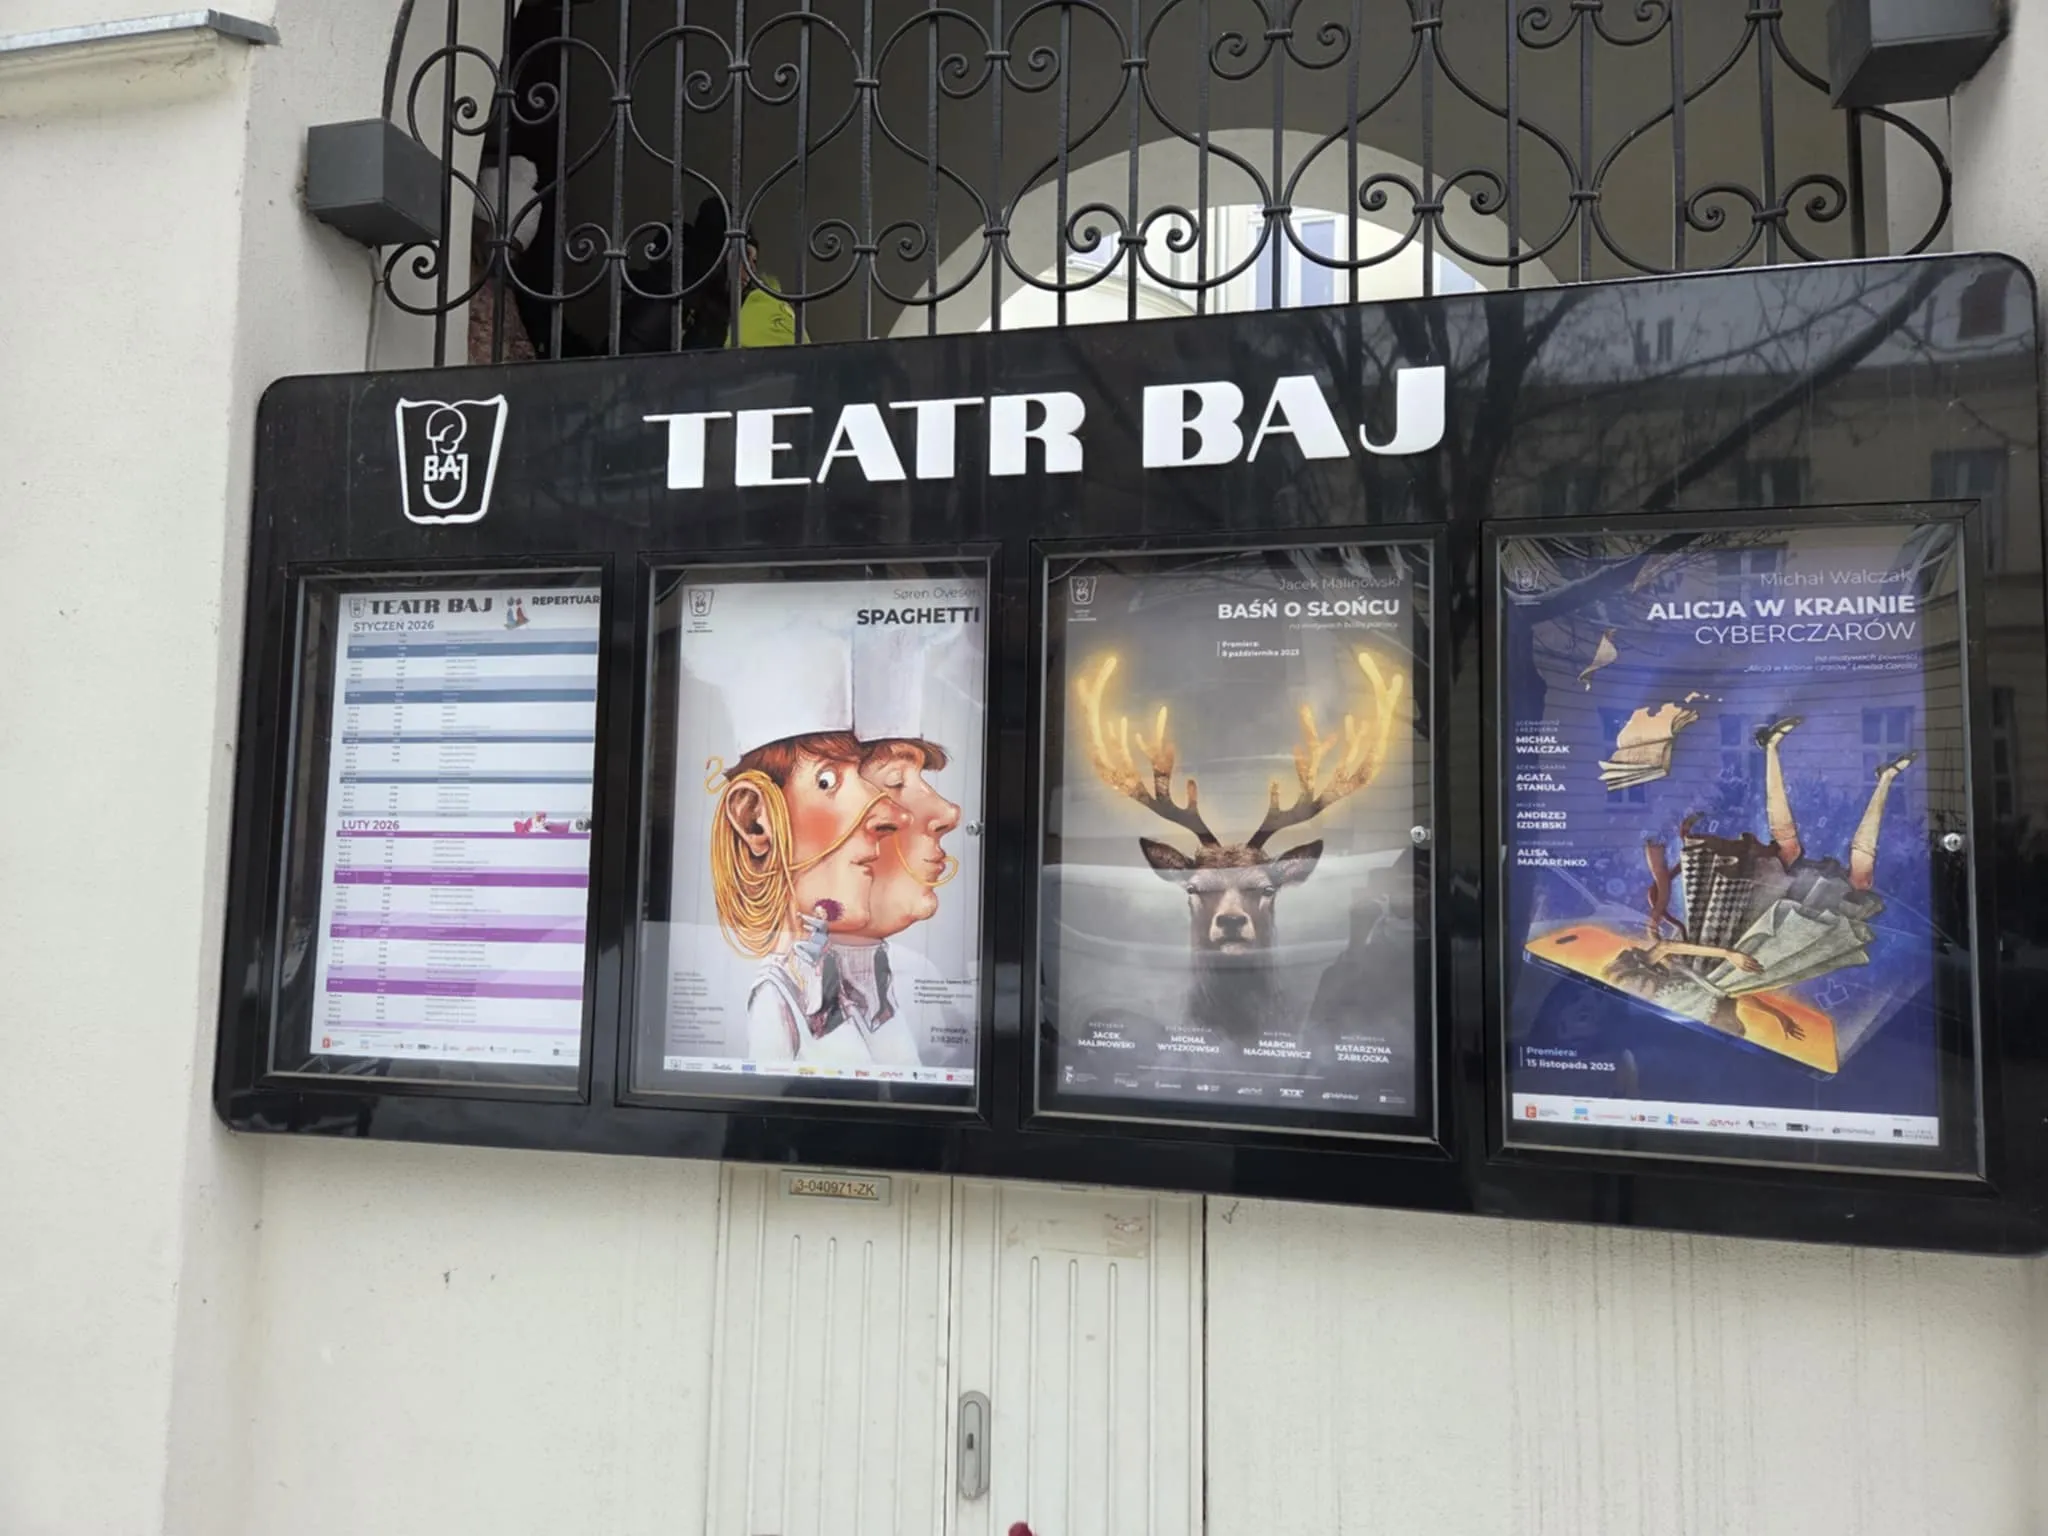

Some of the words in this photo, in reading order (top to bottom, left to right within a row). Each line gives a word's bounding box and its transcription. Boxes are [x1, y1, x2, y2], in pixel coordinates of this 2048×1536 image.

[643, 391, 1087, 490] TEATR
[1142, 365, 1446, 469] BAJ
[424, 453, 469, 510] BAJ
[1761, 571, 1825, 587] Michał
[1829, 568, 1914, 586] Walczak
[370, 597, 441, 615] TEATR
[447, 596, 494, 613] BAJ
[531, 594, 600, 607] REPERTUAR
[1218, 597, 1278, 620] BAŚŃ
[1284, 601, 1301, 617] O
[1307, 595, 1400, 617] SŁOŃCU
[1647, 600, 1748, 621] ALICJA
[1755, 599, 1786, 618] W
[1794, 595, 1917, 616] KRAINIE
[857, 606, 980, 626] SPAGHETTI
[407, 619, 435, 631] 2026
[1695, 617, 1917, 645] CYBERCZARÓW
[1516, 736, 1557, 744] MICHAŁ
[1516, 745, 1570, 754] WALCZAK
[1516, 773, 1552, 782] AGATA
[1516, 783, 1566, 792] STANULA
[1517, 811, 1567, 819] ANDRZEJ
[341, 819, 370, 830] LUTY
[372, 819, 400, 830] 2026
[1517, 821, 1566, 829] IZDEBSKI
[1517, 848, 1549, 857] ALISA
[1518, 858, 1587, 867] MAKARENKO
[1092, 1031, 1121, 1040] JACEK
[1078, 1039, 1136, 1049] MALINOWSKI
[1258, 1040, 1297, 1049] MARCIN
[1335, 1044, 1392, 1054] KATARZYNA
[1526, 1046, 1578, 1057] Premiera:
[1526, 1059, 1537, 1067] 15
[1539, 1058, 1588, 1070] listopada
[1589, 1062, 1616, 1071] 2025
